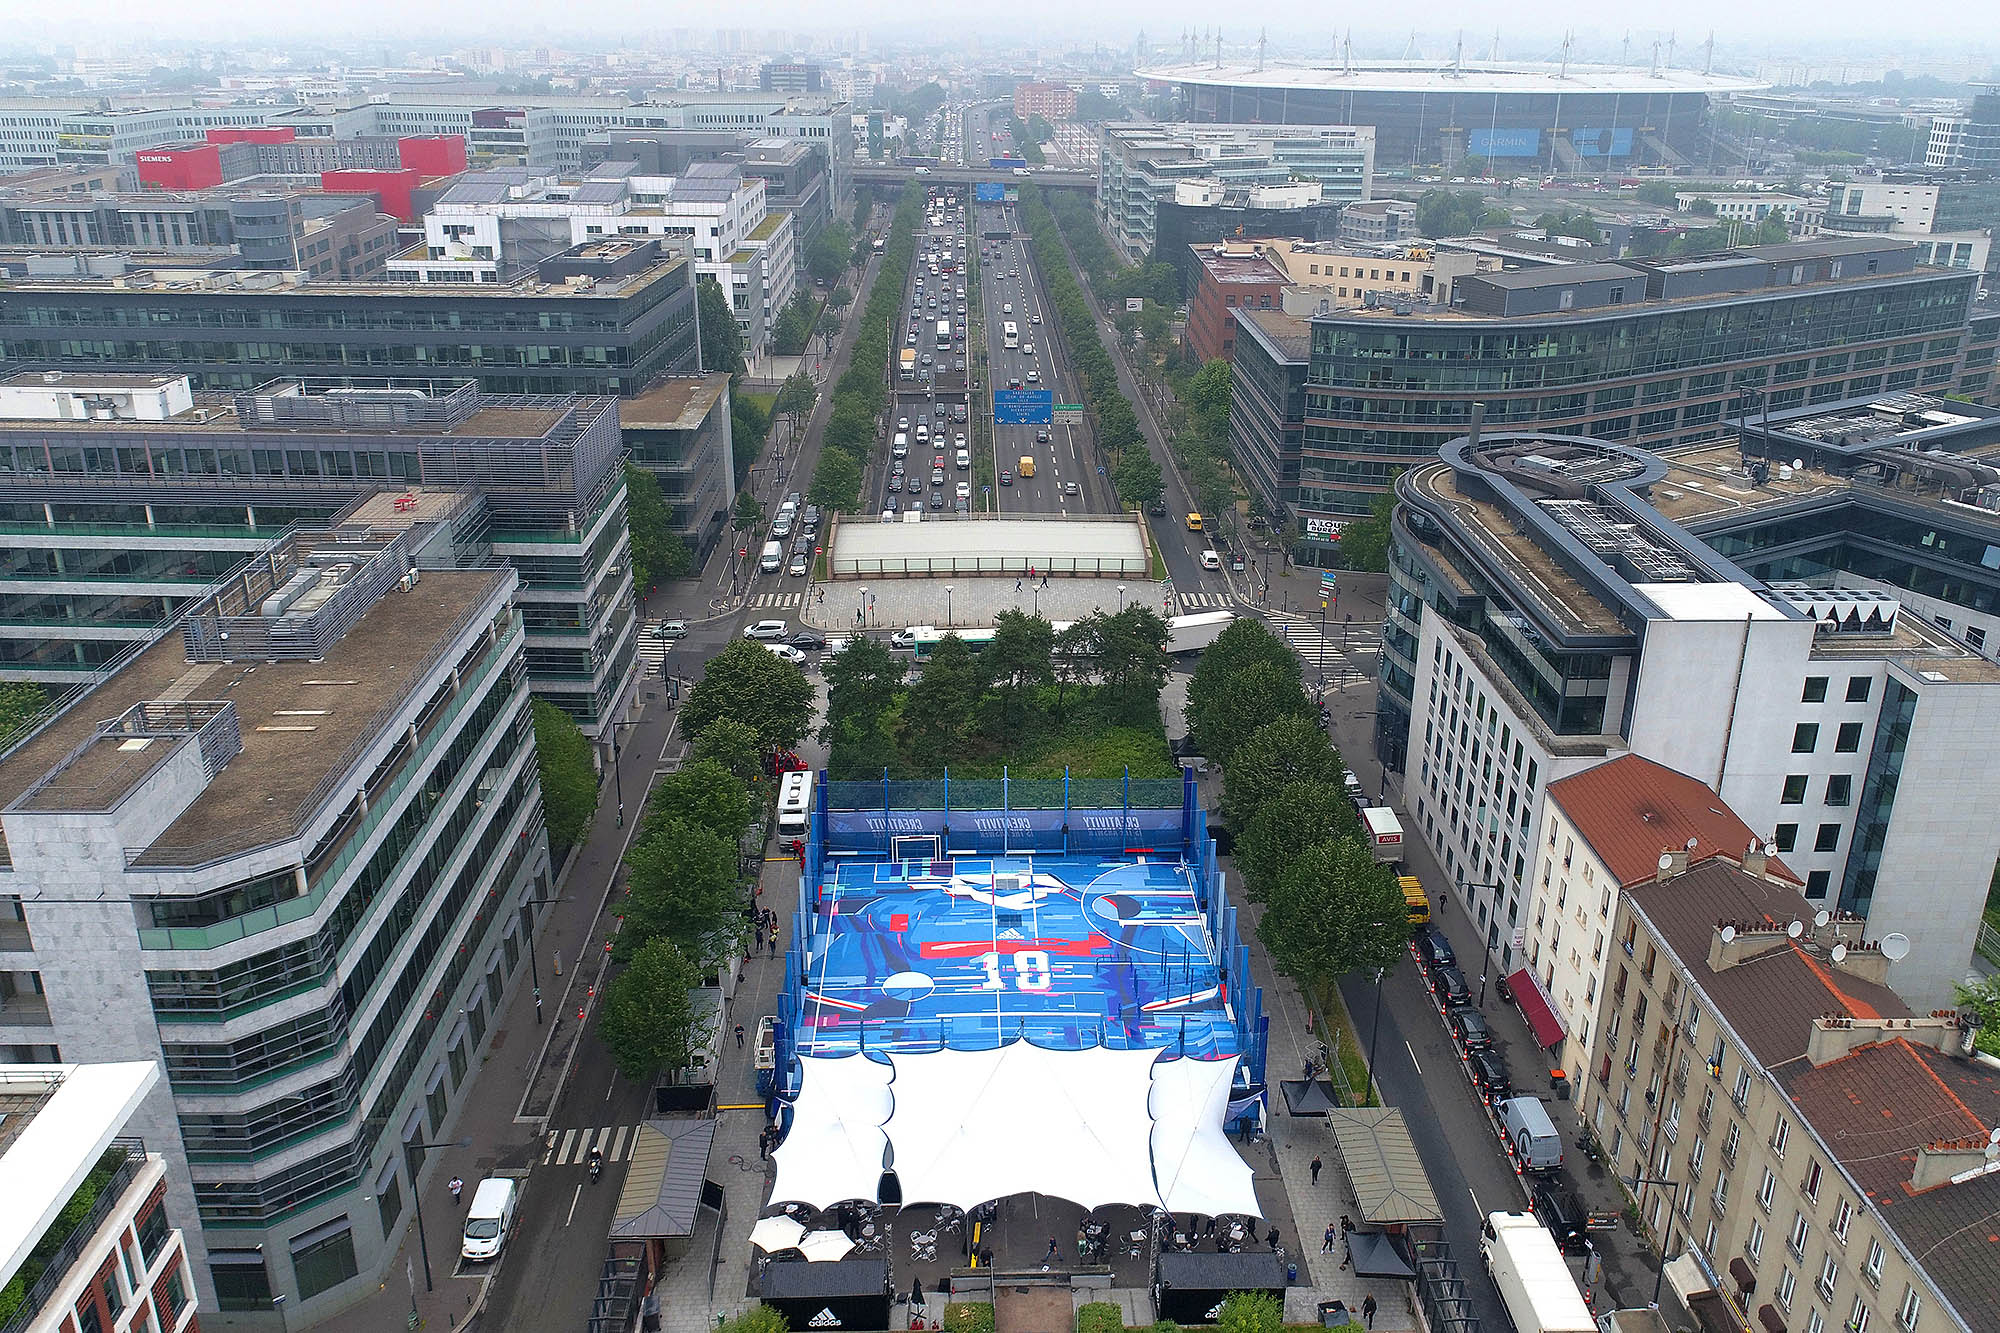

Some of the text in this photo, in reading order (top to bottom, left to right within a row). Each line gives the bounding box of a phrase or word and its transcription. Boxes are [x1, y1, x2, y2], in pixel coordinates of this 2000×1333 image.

[1480, 137, 1527, 146] GARMIN
[140, 155, 172, 163] SIEMENS
[808, 1319, 842, 1327] adidas
